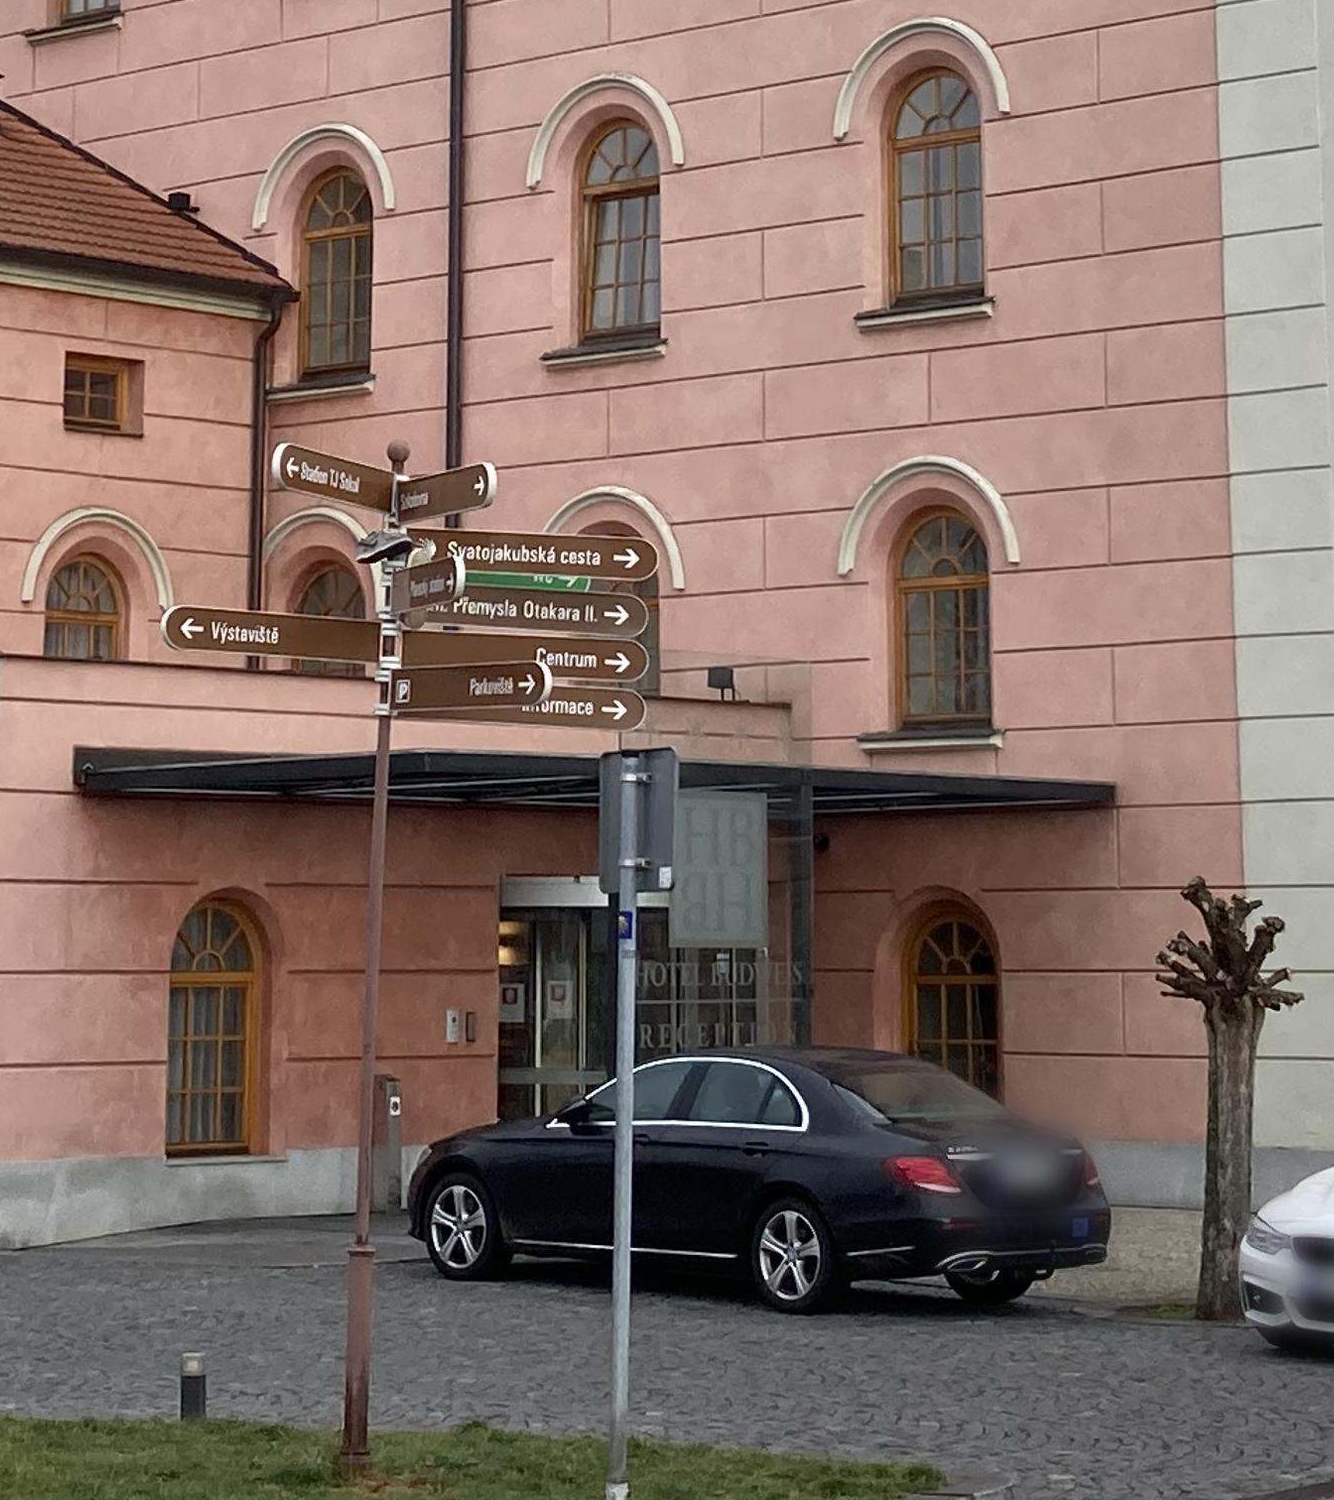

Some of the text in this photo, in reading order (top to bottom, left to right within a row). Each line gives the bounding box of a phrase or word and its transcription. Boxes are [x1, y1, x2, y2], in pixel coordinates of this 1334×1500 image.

[447, 540, 602, 567] Svatojakubská cesta
[453, 596, 517, 618] Přemysla
[523, 600, 580, 622] Otakara
[211, 621, 280, 645] Výstaviště
[536, 647, 598, 668] Centrum
[636, 960, 705, 987] HOTEL
